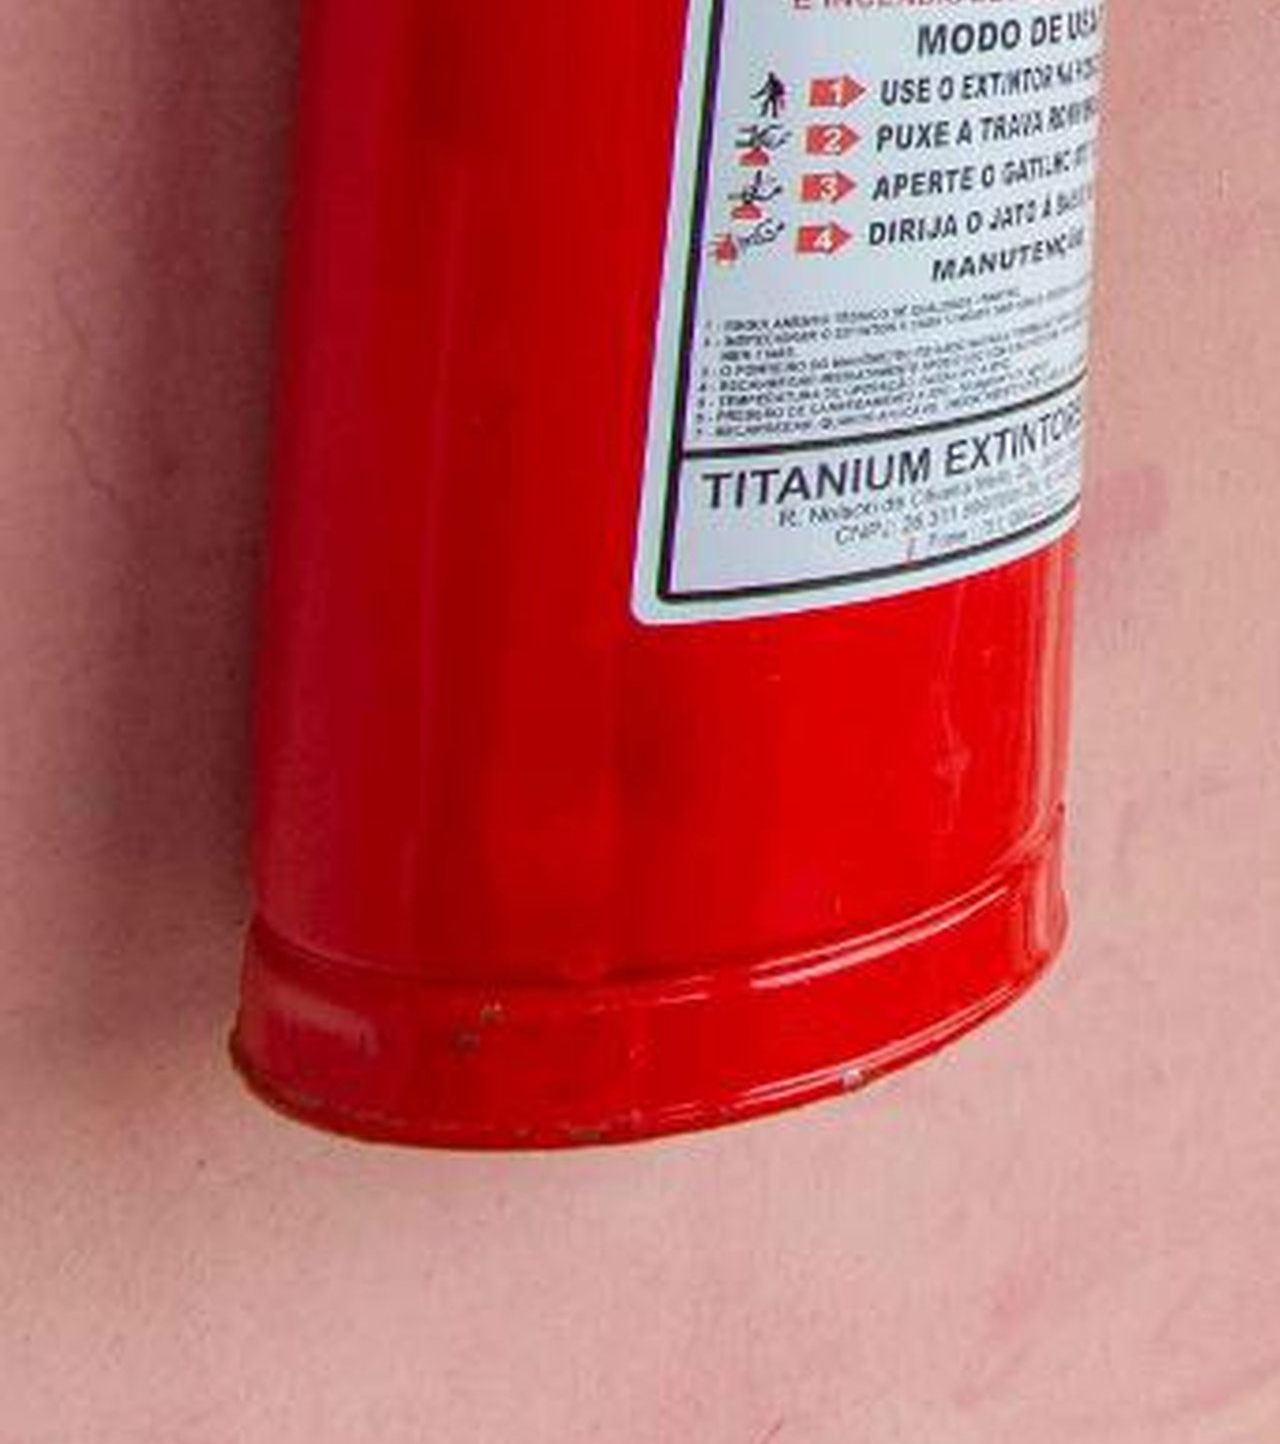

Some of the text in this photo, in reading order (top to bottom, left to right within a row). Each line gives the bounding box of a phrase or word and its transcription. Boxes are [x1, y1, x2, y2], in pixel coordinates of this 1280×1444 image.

[917, 18, 1021, 58] MODO
[1031, 14, 1062, 47] DE
[880, 77, 931, 106] USE
[938, 76, 954, 101] O
[961, 64, 1052, 100] EXTINTOR
[823, 128, 842, 152] 2
[876, 121, 949, 152] PUXE
[957, 120, 972, 144] A
[980, 113, 1043, 142] TRAVA
[819, 177, 838, 201] 3
[872, 165, 973, 202] APERTE
[981, 165, 995, 188] O
[813, 227, 835, 249] 4
[869, 214, 957, 246] DIRIJA
[966, 210, 983, 234] O
[703, 447, 930, 509] TITANIUM
